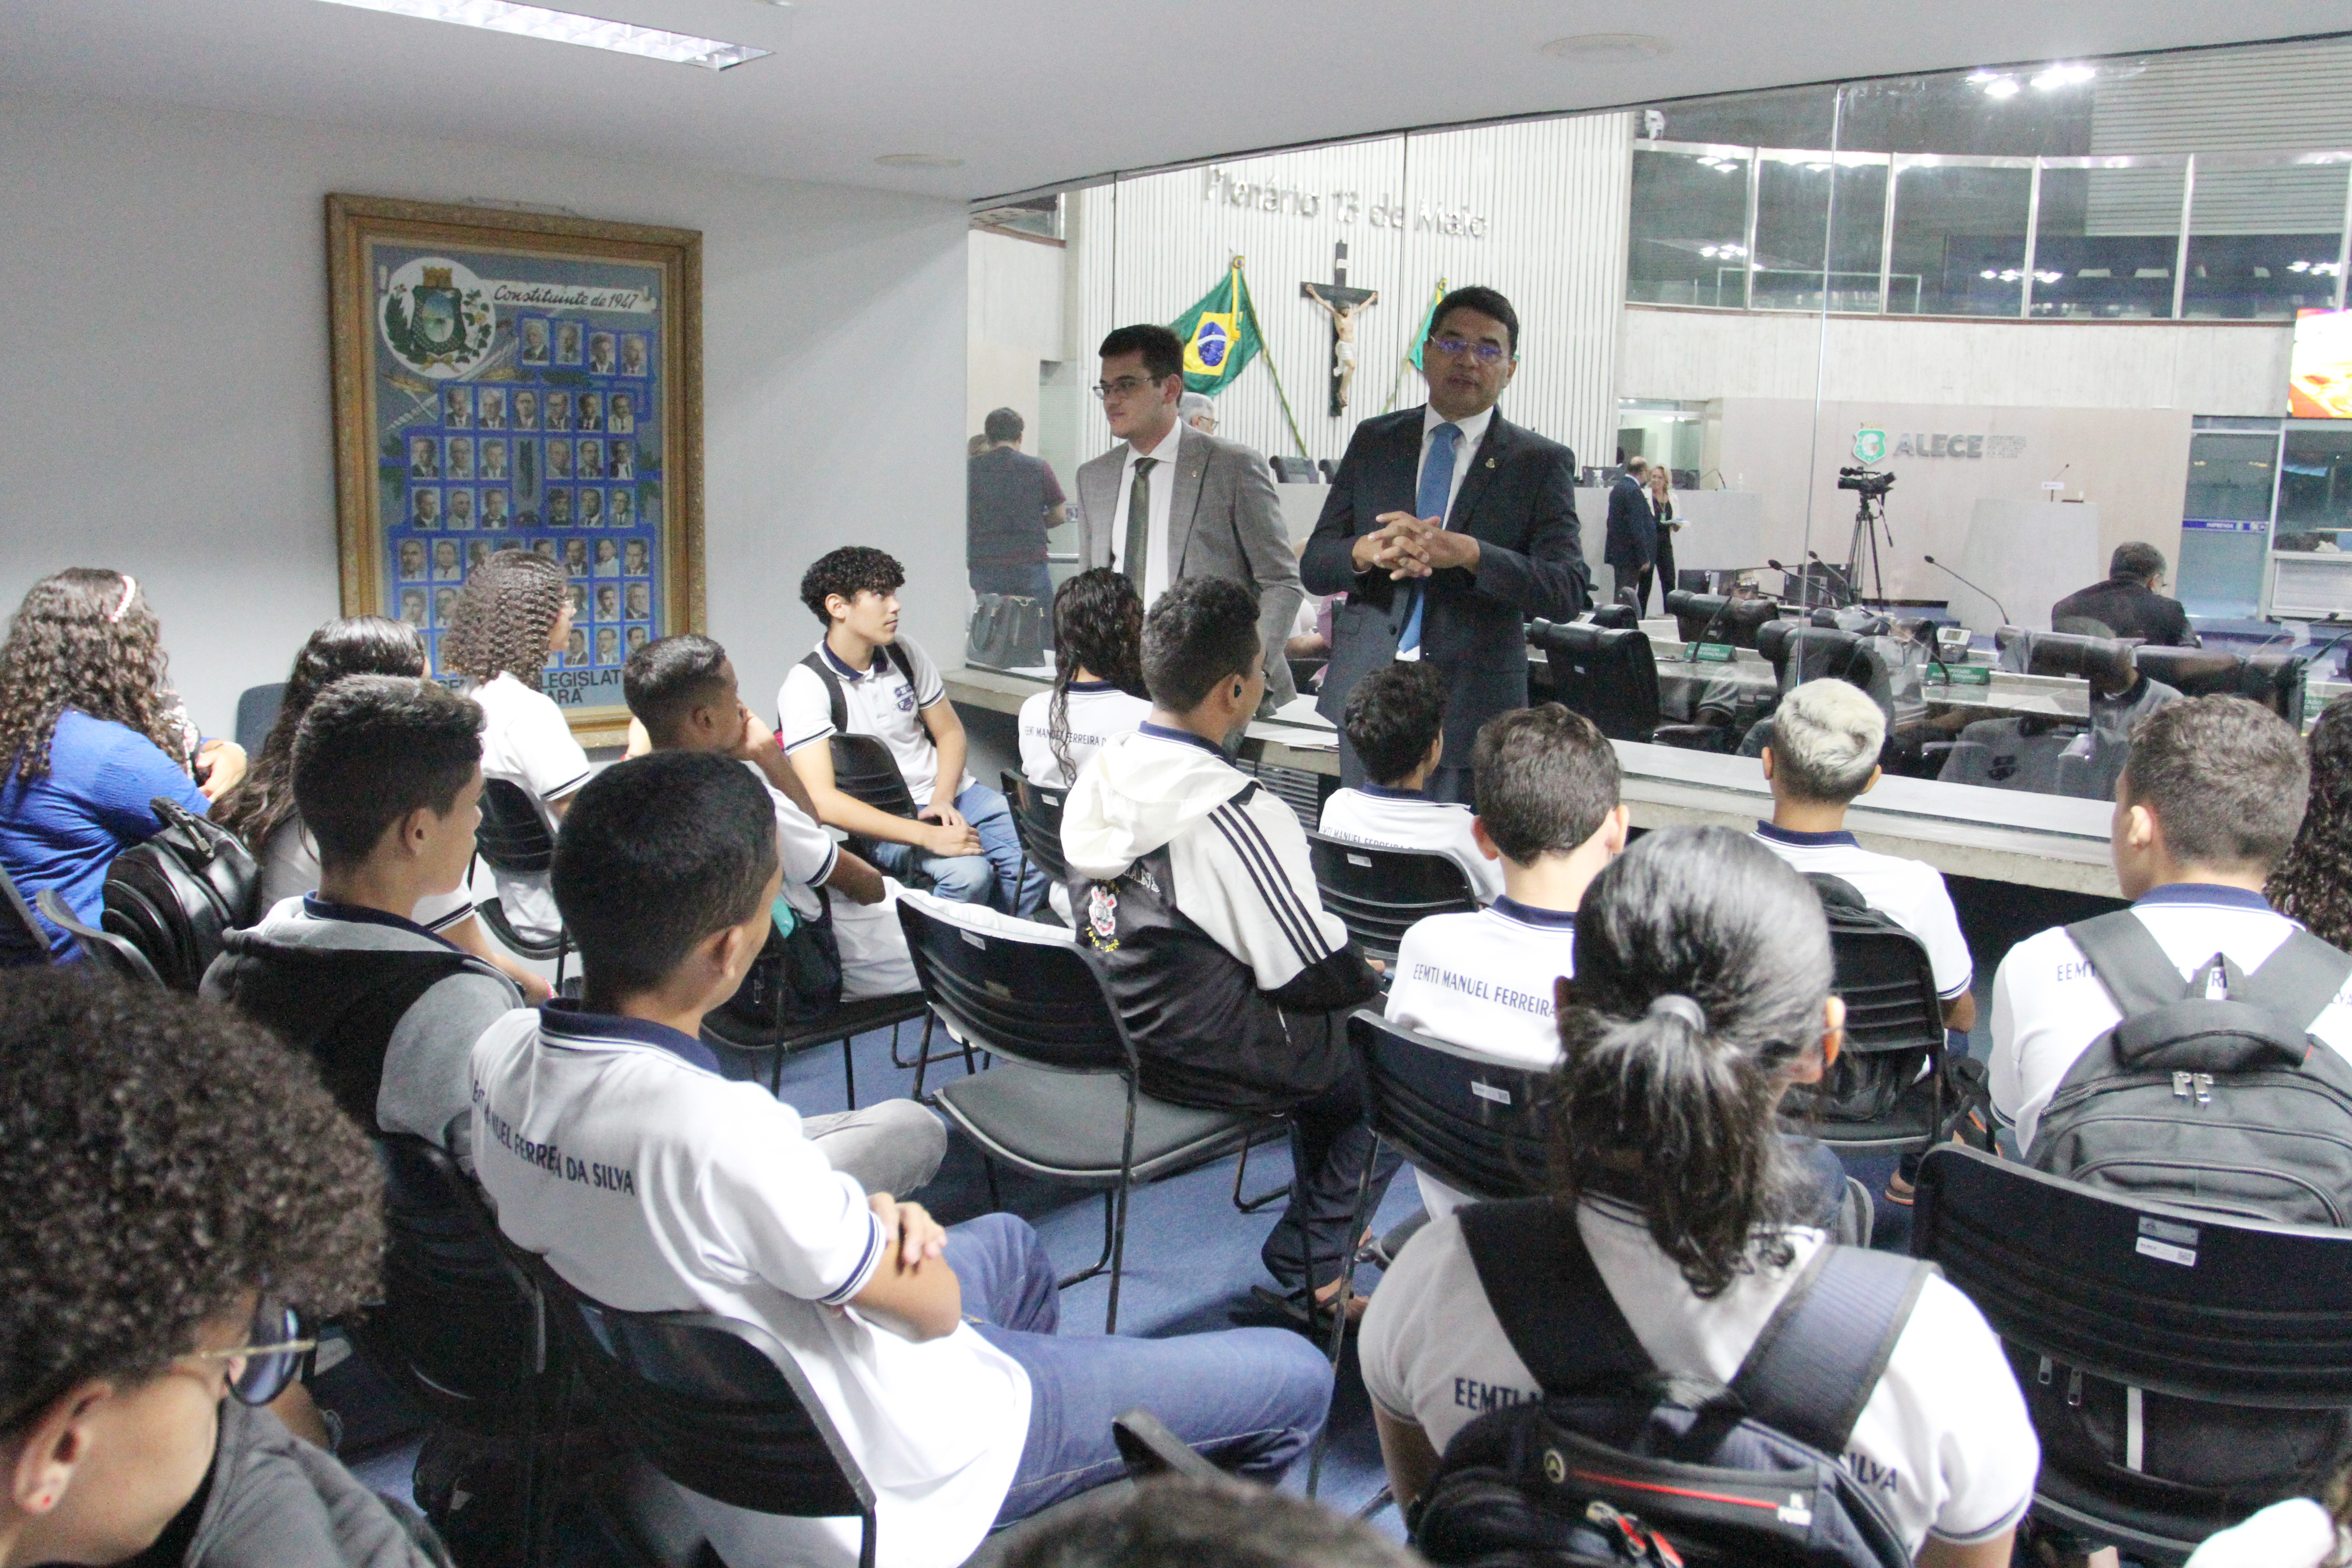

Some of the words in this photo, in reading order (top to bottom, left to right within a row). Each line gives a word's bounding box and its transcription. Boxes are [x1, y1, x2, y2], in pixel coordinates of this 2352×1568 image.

[1202, 164, 1321, 217] Plenário
[1332, 190, 1360, 222] 13
[1370, 193, 1403, 228] de
[1414, 199, 1488, 237] Maio
[494, 284, 588, 305] Constituinte
[591, 293, 607, 307] de
[608, 294, 638, 309] 1947
[1893, 433, 1984, 458] ALECE
[540, 669, 621, 689] LEGISLAT
[1413, 964, 1439, 984] EEMTI
[1442, 970, 1489, 999] MANUEL
[567, 1156, 589, 1185] DA
[593, 1162, 635, 1196] SILVA
[1455, 1377, 1519, 1411] EEMTI
[1850, 1453, 1897, 1493] ILVA
